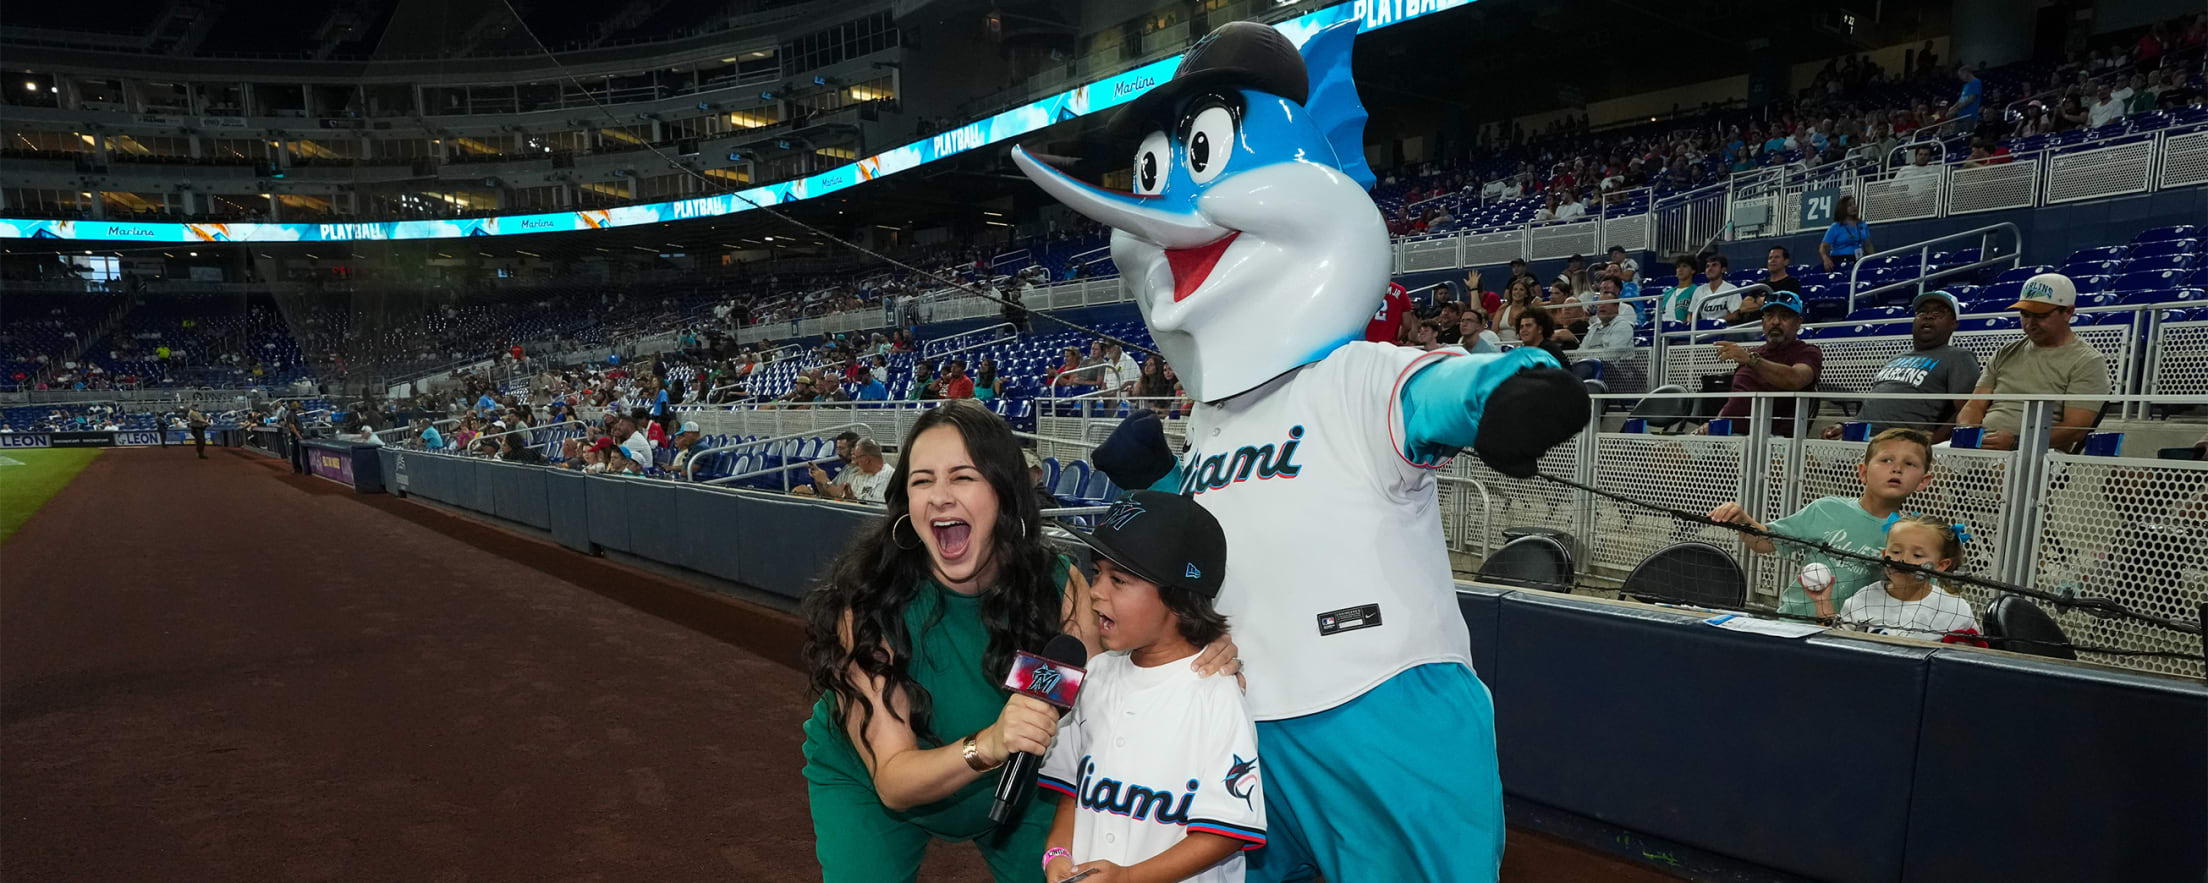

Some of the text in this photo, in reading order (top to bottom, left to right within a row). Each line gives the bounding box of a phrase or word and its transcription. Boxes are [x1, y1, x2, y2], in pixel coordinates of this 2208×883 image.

[1353, 0, 1468, 32] PLAYB
[1112, 76, 1155, 99] Marlins
[934, 123, 984, 158] PLAYBALL
[673, 196, 726, 218] PLAYBALL
[1807, 195, 1832, 220] 24
[107, 226, 155, 237] Marlins
[320, 223, 386, 240] PLAYBALL
[520, 219, 554, 228] Marlins
[2024, 282, 2054, 299] RLINS
[1875, 367, 1928, 387] MARLINS
[1, 436, 48, 447] LEON
[125, 432, 159, 445] LEON
